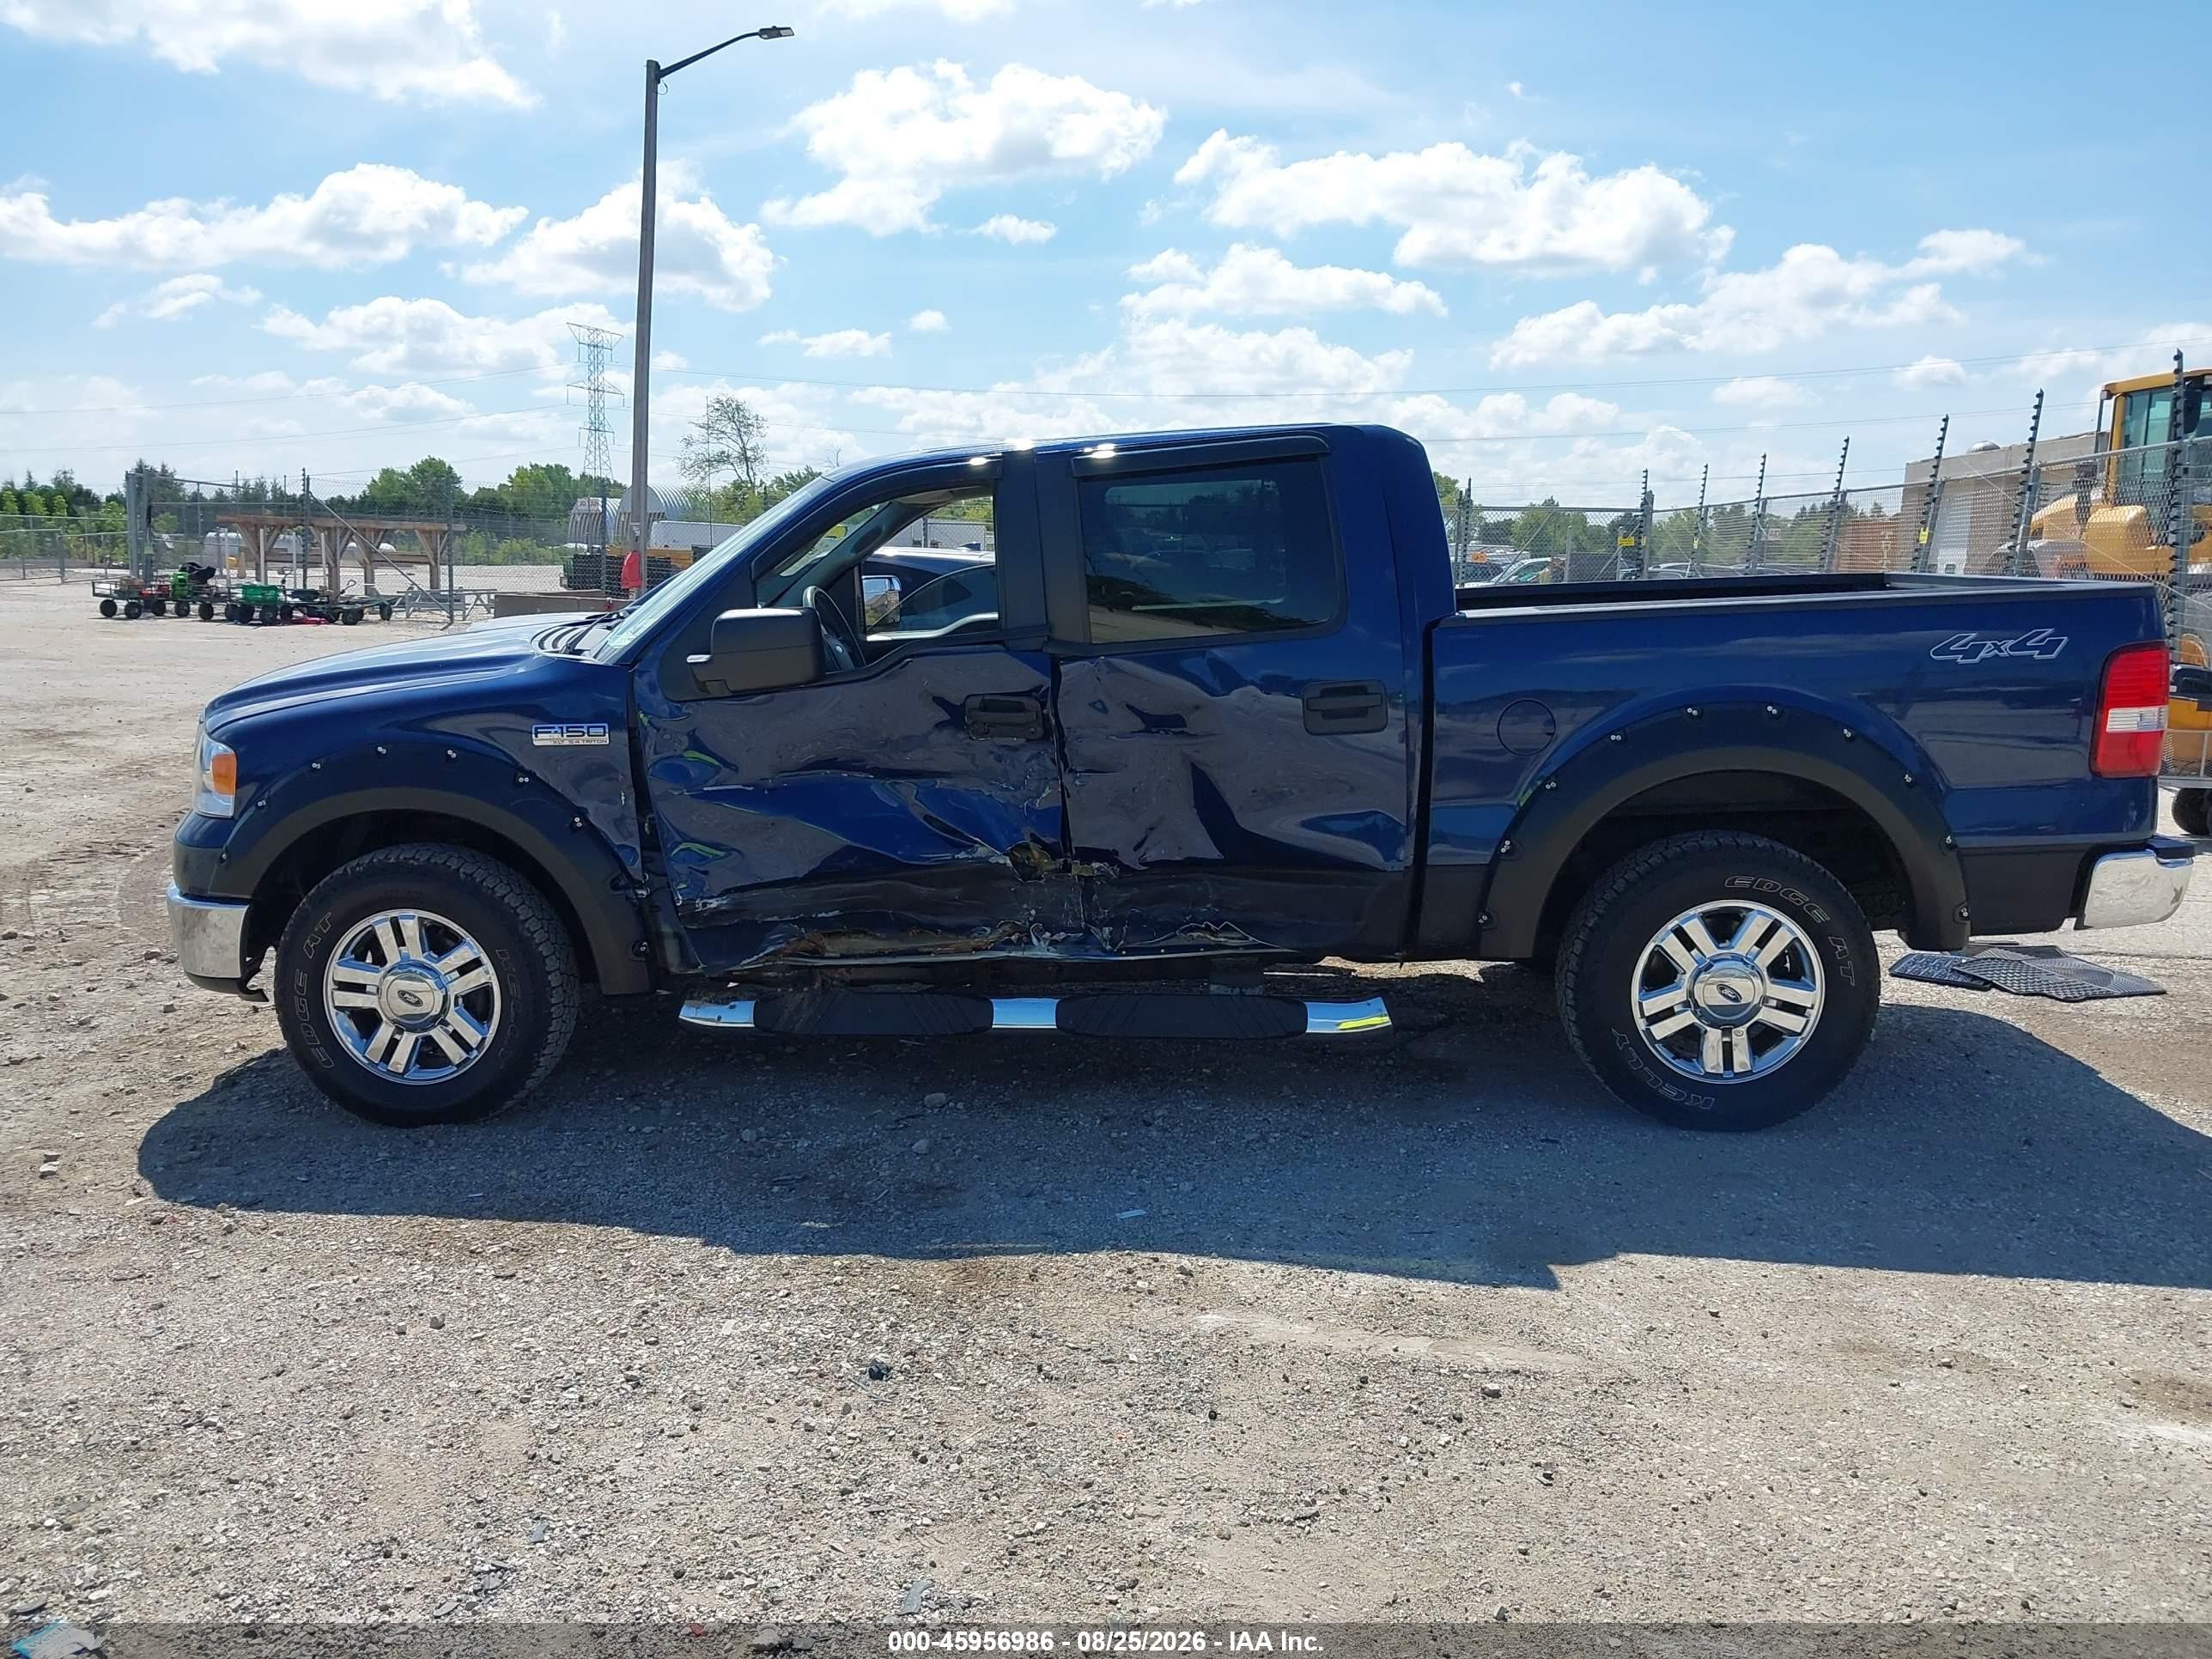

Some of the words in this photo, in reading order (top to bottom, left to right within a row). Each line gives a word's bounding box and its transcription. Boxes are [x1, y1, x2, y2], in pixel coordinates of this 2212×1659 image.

[1929, 628, 2069, 665] 4x4
[303, 912, 331, 959] AT
[1724, 876, 1831, 923] EDGE
[1827, 936, 1855, 987] AT
[295, 968, 335, 1068] EDGE
[1611, 1028, 1716, 1109] KELLY
